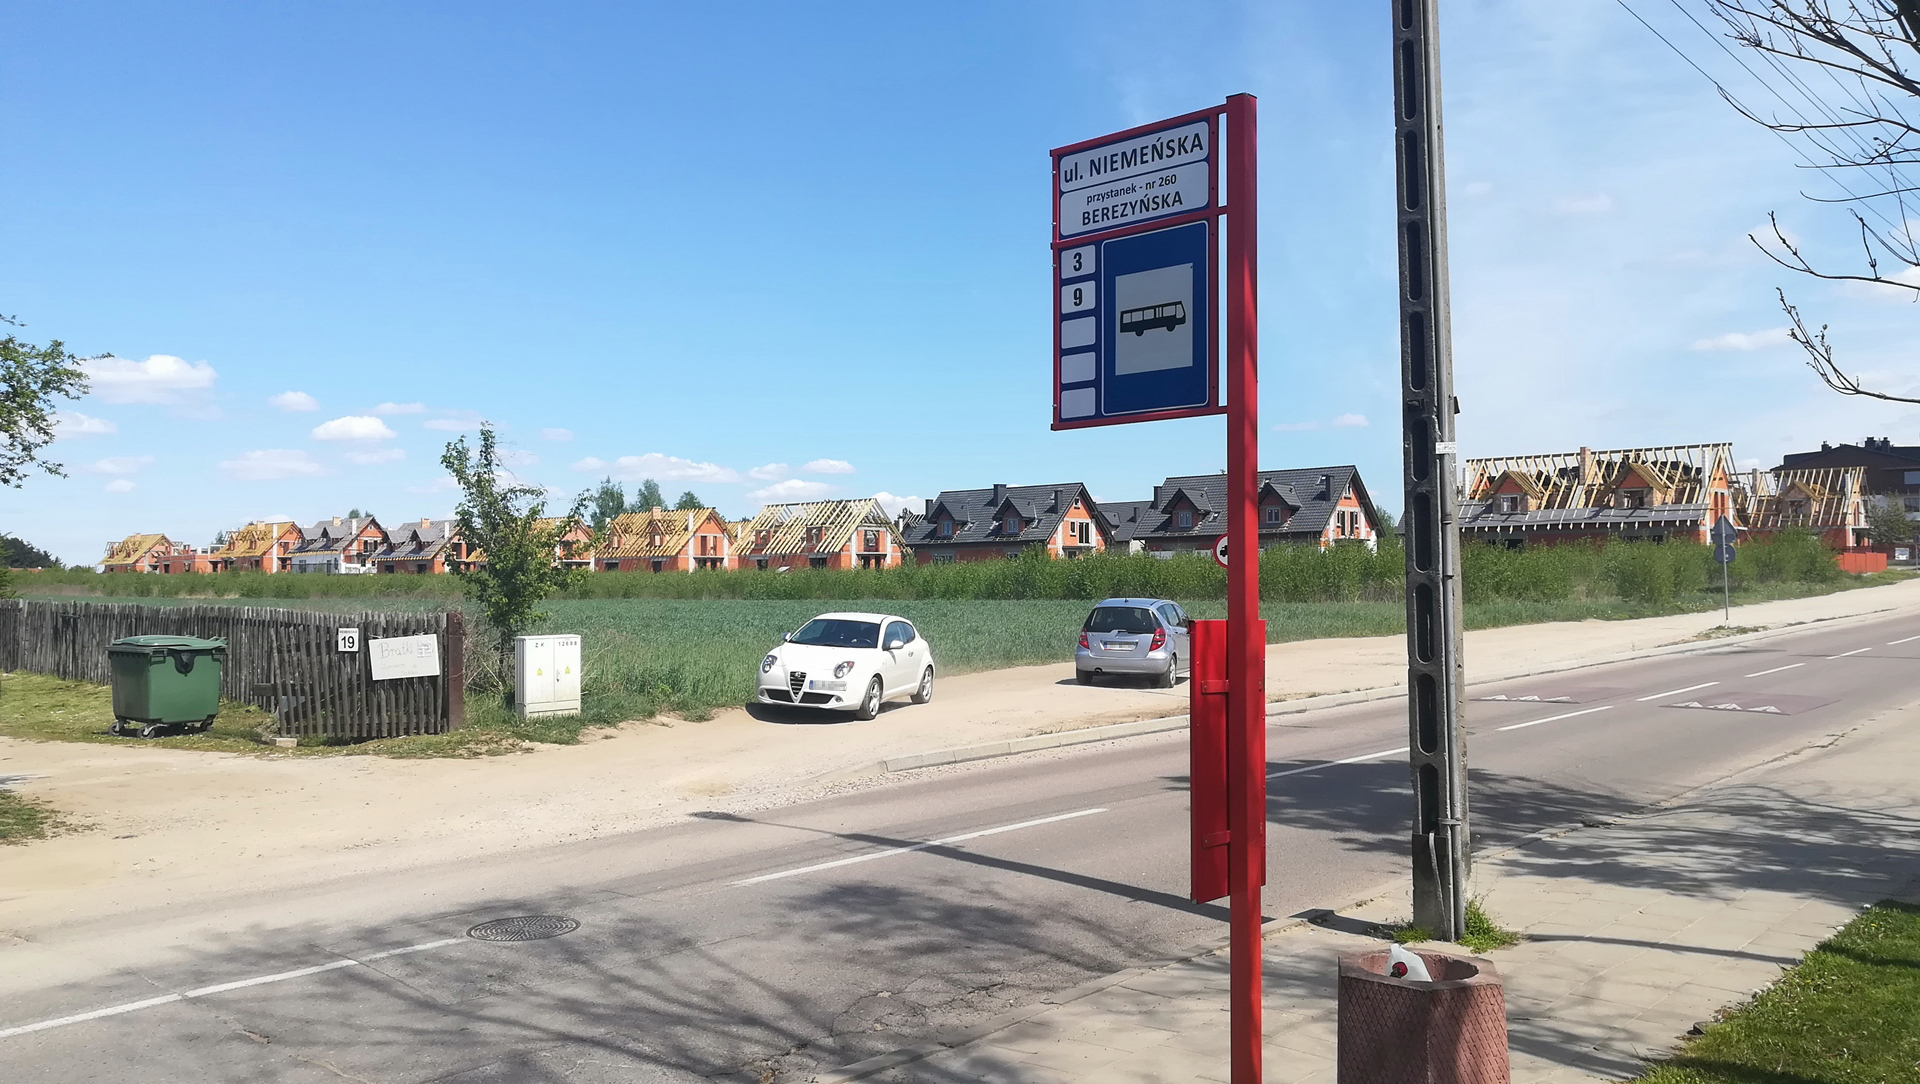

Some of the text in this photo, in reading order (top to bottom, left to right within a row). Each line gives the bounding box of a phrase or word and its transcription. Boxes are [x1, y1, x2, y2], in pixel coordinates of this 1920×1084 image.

[1064, 132, 1204, 183] ul. NIEMEŃSKA
[1086, 183, 1137, 206] przystanek
[1145, 180, 1156, 190] nr
[1158, 173, 1177, 188] 260
[1082, 190, 1184, 226] BEREZYŃSKA
[1073, 252, 1083, 272] 3
[1073, 287, 1083, 307] 9
[341, 635, 355, 649] 19
